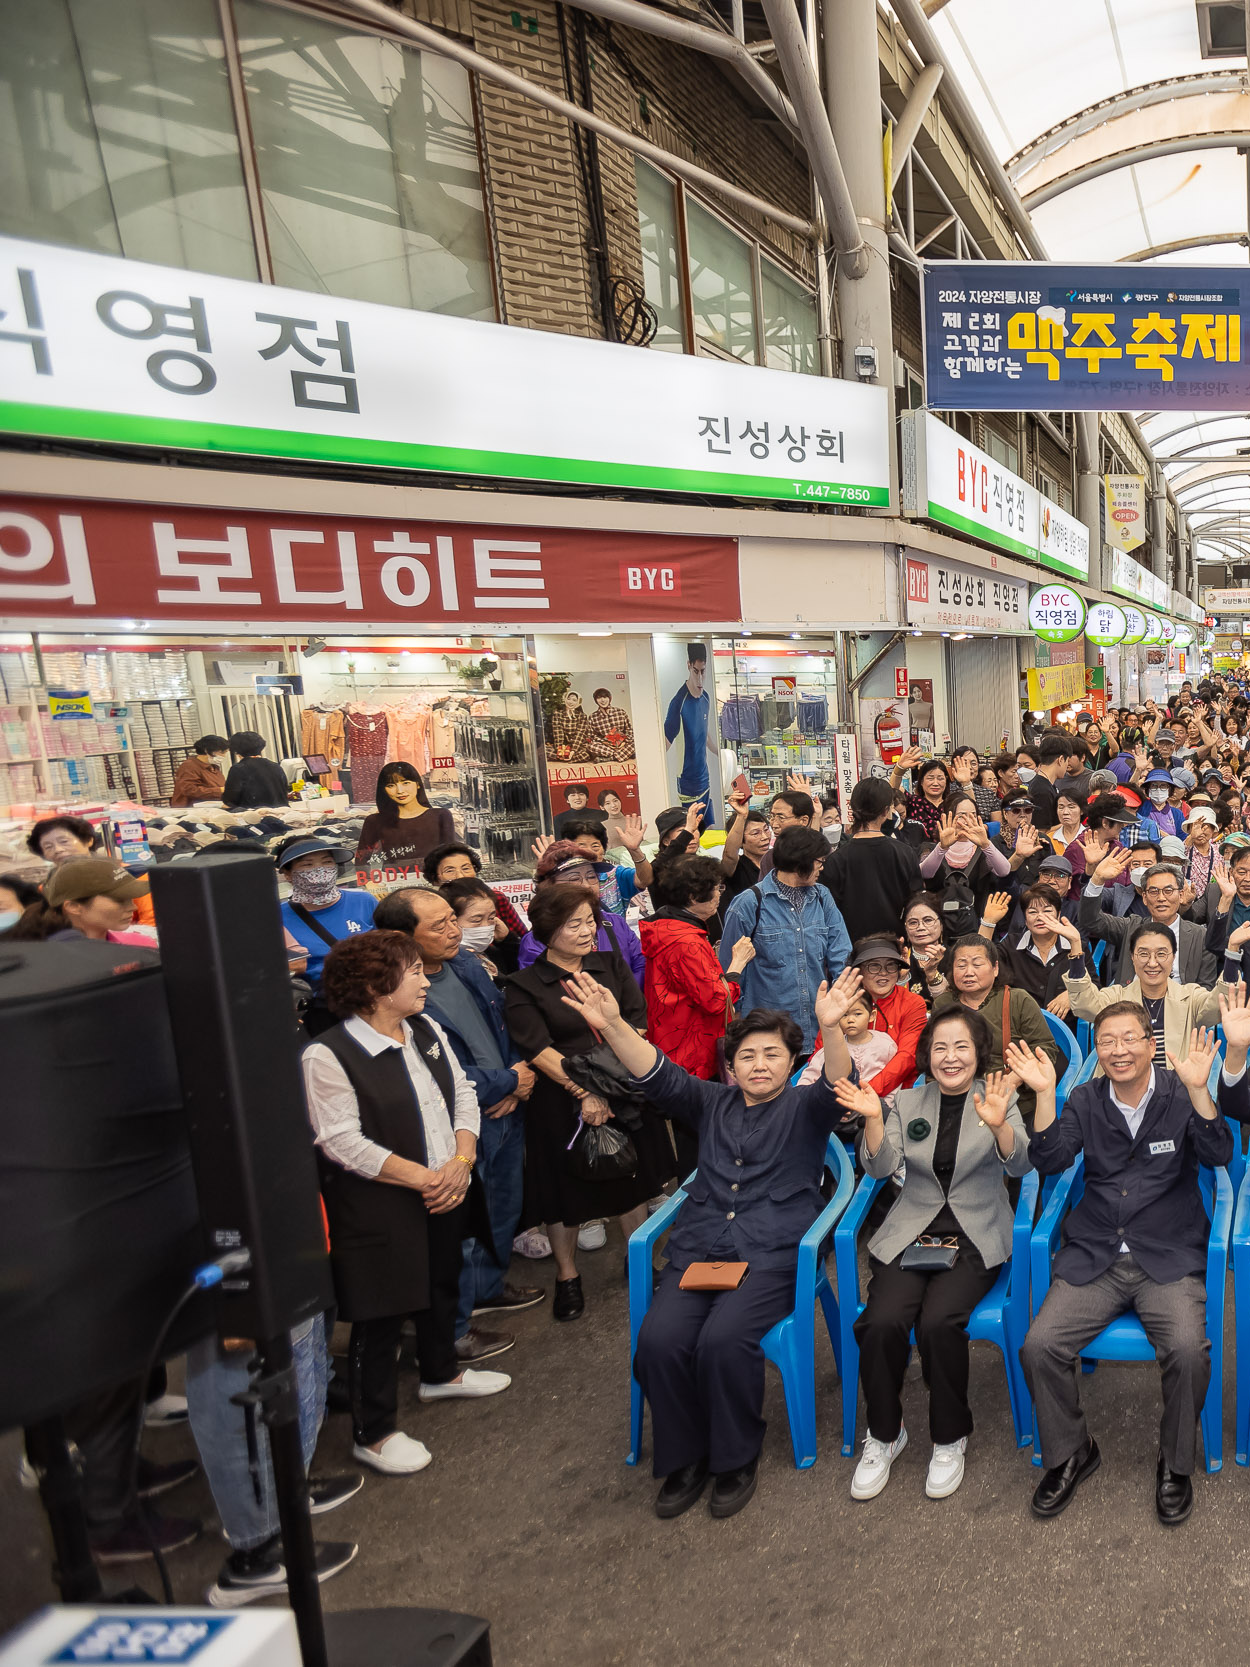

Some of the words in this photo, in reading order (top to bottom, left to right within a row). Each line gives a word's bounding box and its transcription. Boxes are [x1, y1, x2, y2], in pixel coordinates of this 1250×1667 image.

[938, 290, 967, 304] 2024
[968, 290, 1042, 305] 자양전통시장
[1077, 293, 1113, 303] 서울특별시
[942, 311, 962, 330] 제
[968, 311, 1000, 331] 2회
[942, 334, 1003, 356] 고객과
[1007, 311, 1122, 381] 맥주
[1125, 311, 1242, 382] 축제
[943, 356, 1023, 379] 함께하는
[698, 415, 846, 464] 진성상회
[792, 482, 871, 502] T.447-7850
[957, 447, 988, 514] BYC
[992, 473, 1026, 533] 직영점
[1115, 511, 1136, 520] OPEN
[152, 519, 551, 612] 보디히트
[627, 566, 675, 591] BYC
[910, 565, 927, 600] BYC
[937, 569, 986, 609] 진성상회
[992, 582, 1019, 614] 직영점
[1041, 593, 1070, 607] BYC
[1035, 609, 1078, 626] 직영점
[1097, 609, 1114, 619] 하림
[1099, 619, 1112, 633] 닭
[55, 703, 86, 712] NSOK
[434, 757, 454, 768] BYC
[548, 766, 591, 781] HOME
[592, 763, 638, 778] WEAR
[345, 919, 362, 933] LA
